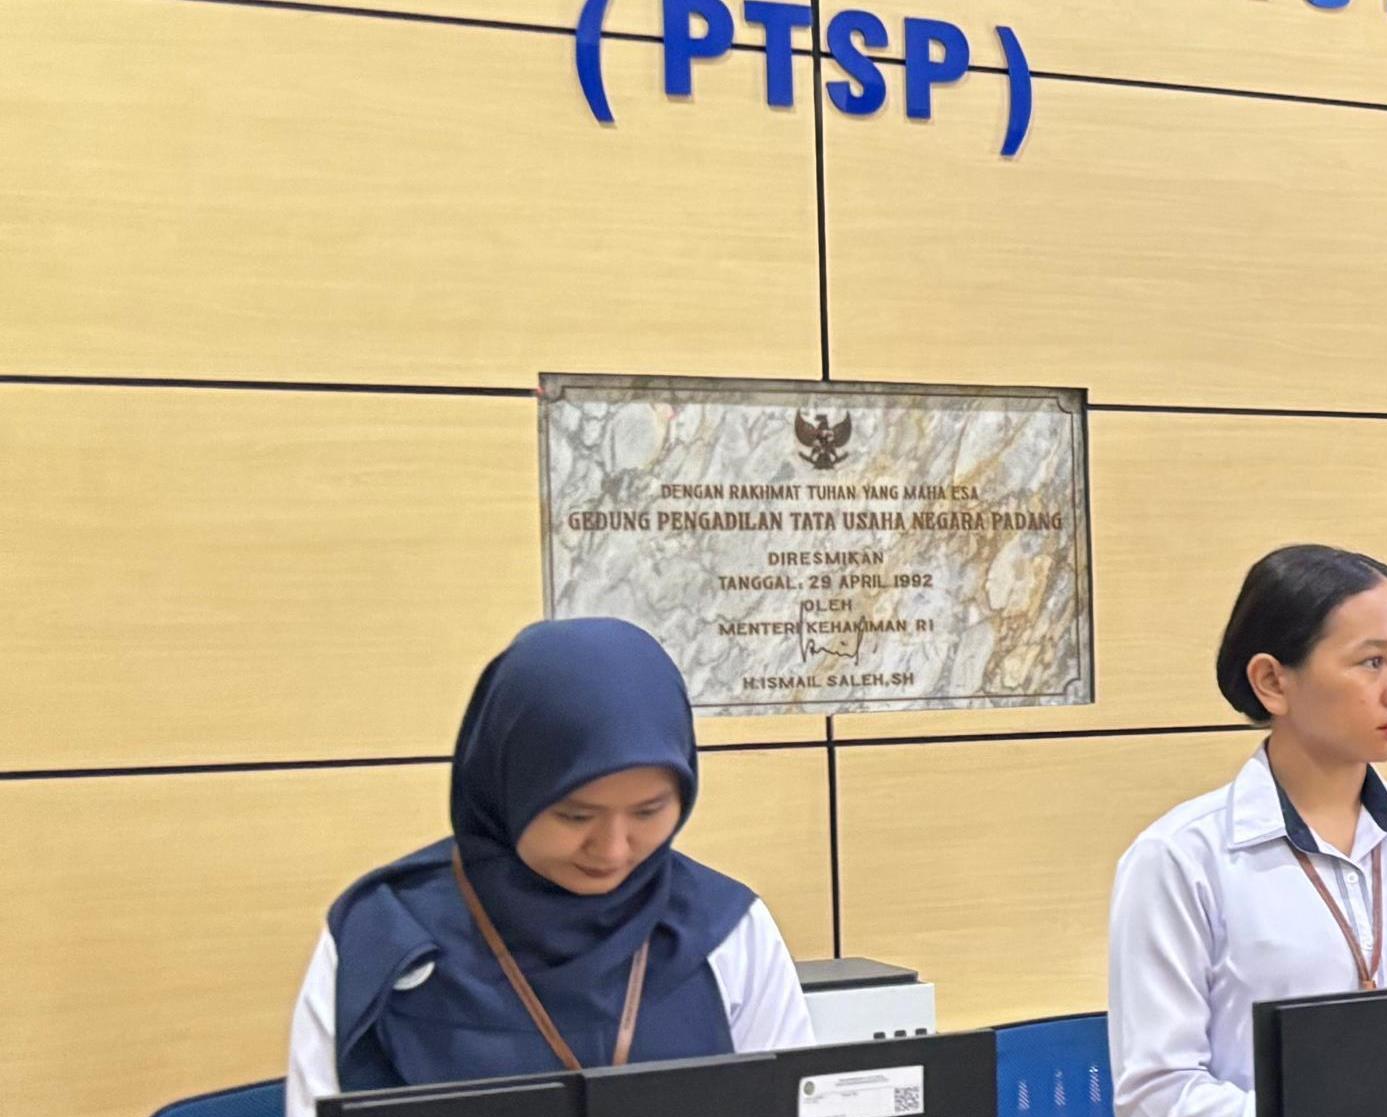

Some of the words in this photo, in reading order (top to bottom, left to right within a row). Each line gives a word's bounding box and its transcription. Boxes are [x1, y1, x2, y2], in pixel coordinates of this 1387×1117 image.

[662, 484, 724, 499] DENGAN
[729, 484, 801, 499] RAKHMAT
[808, 485, 856, 500] TUHAN
[863, 485, 899, 500] YANG
[903, 485, 946, 500] MAHA
[952, 486, 980, 500] ESA
[568, 511, 650, 531] GEDUNG
[657, 511, 783, 531] PENGADILAN
[790, 511, 836, 531] TATA
[842, 511, 906, 531] USAHA
[911, 511, 986, 531] NEGARA
[992, 511, 1063, 531] PADANG
[768, 551, 885, 566] DIRESMIKAN
[809, 575, 832, 589] 29
[839, 574, 887, 588] APRIL
[893, 574, 933, 588] 1992
[804, 599, 852, 611] OLEH
[718, 621, 800, 635] MENTERI
[806, 619, 907, 634] KEHAKIMAN
[916, 619, 934, 632] RI
